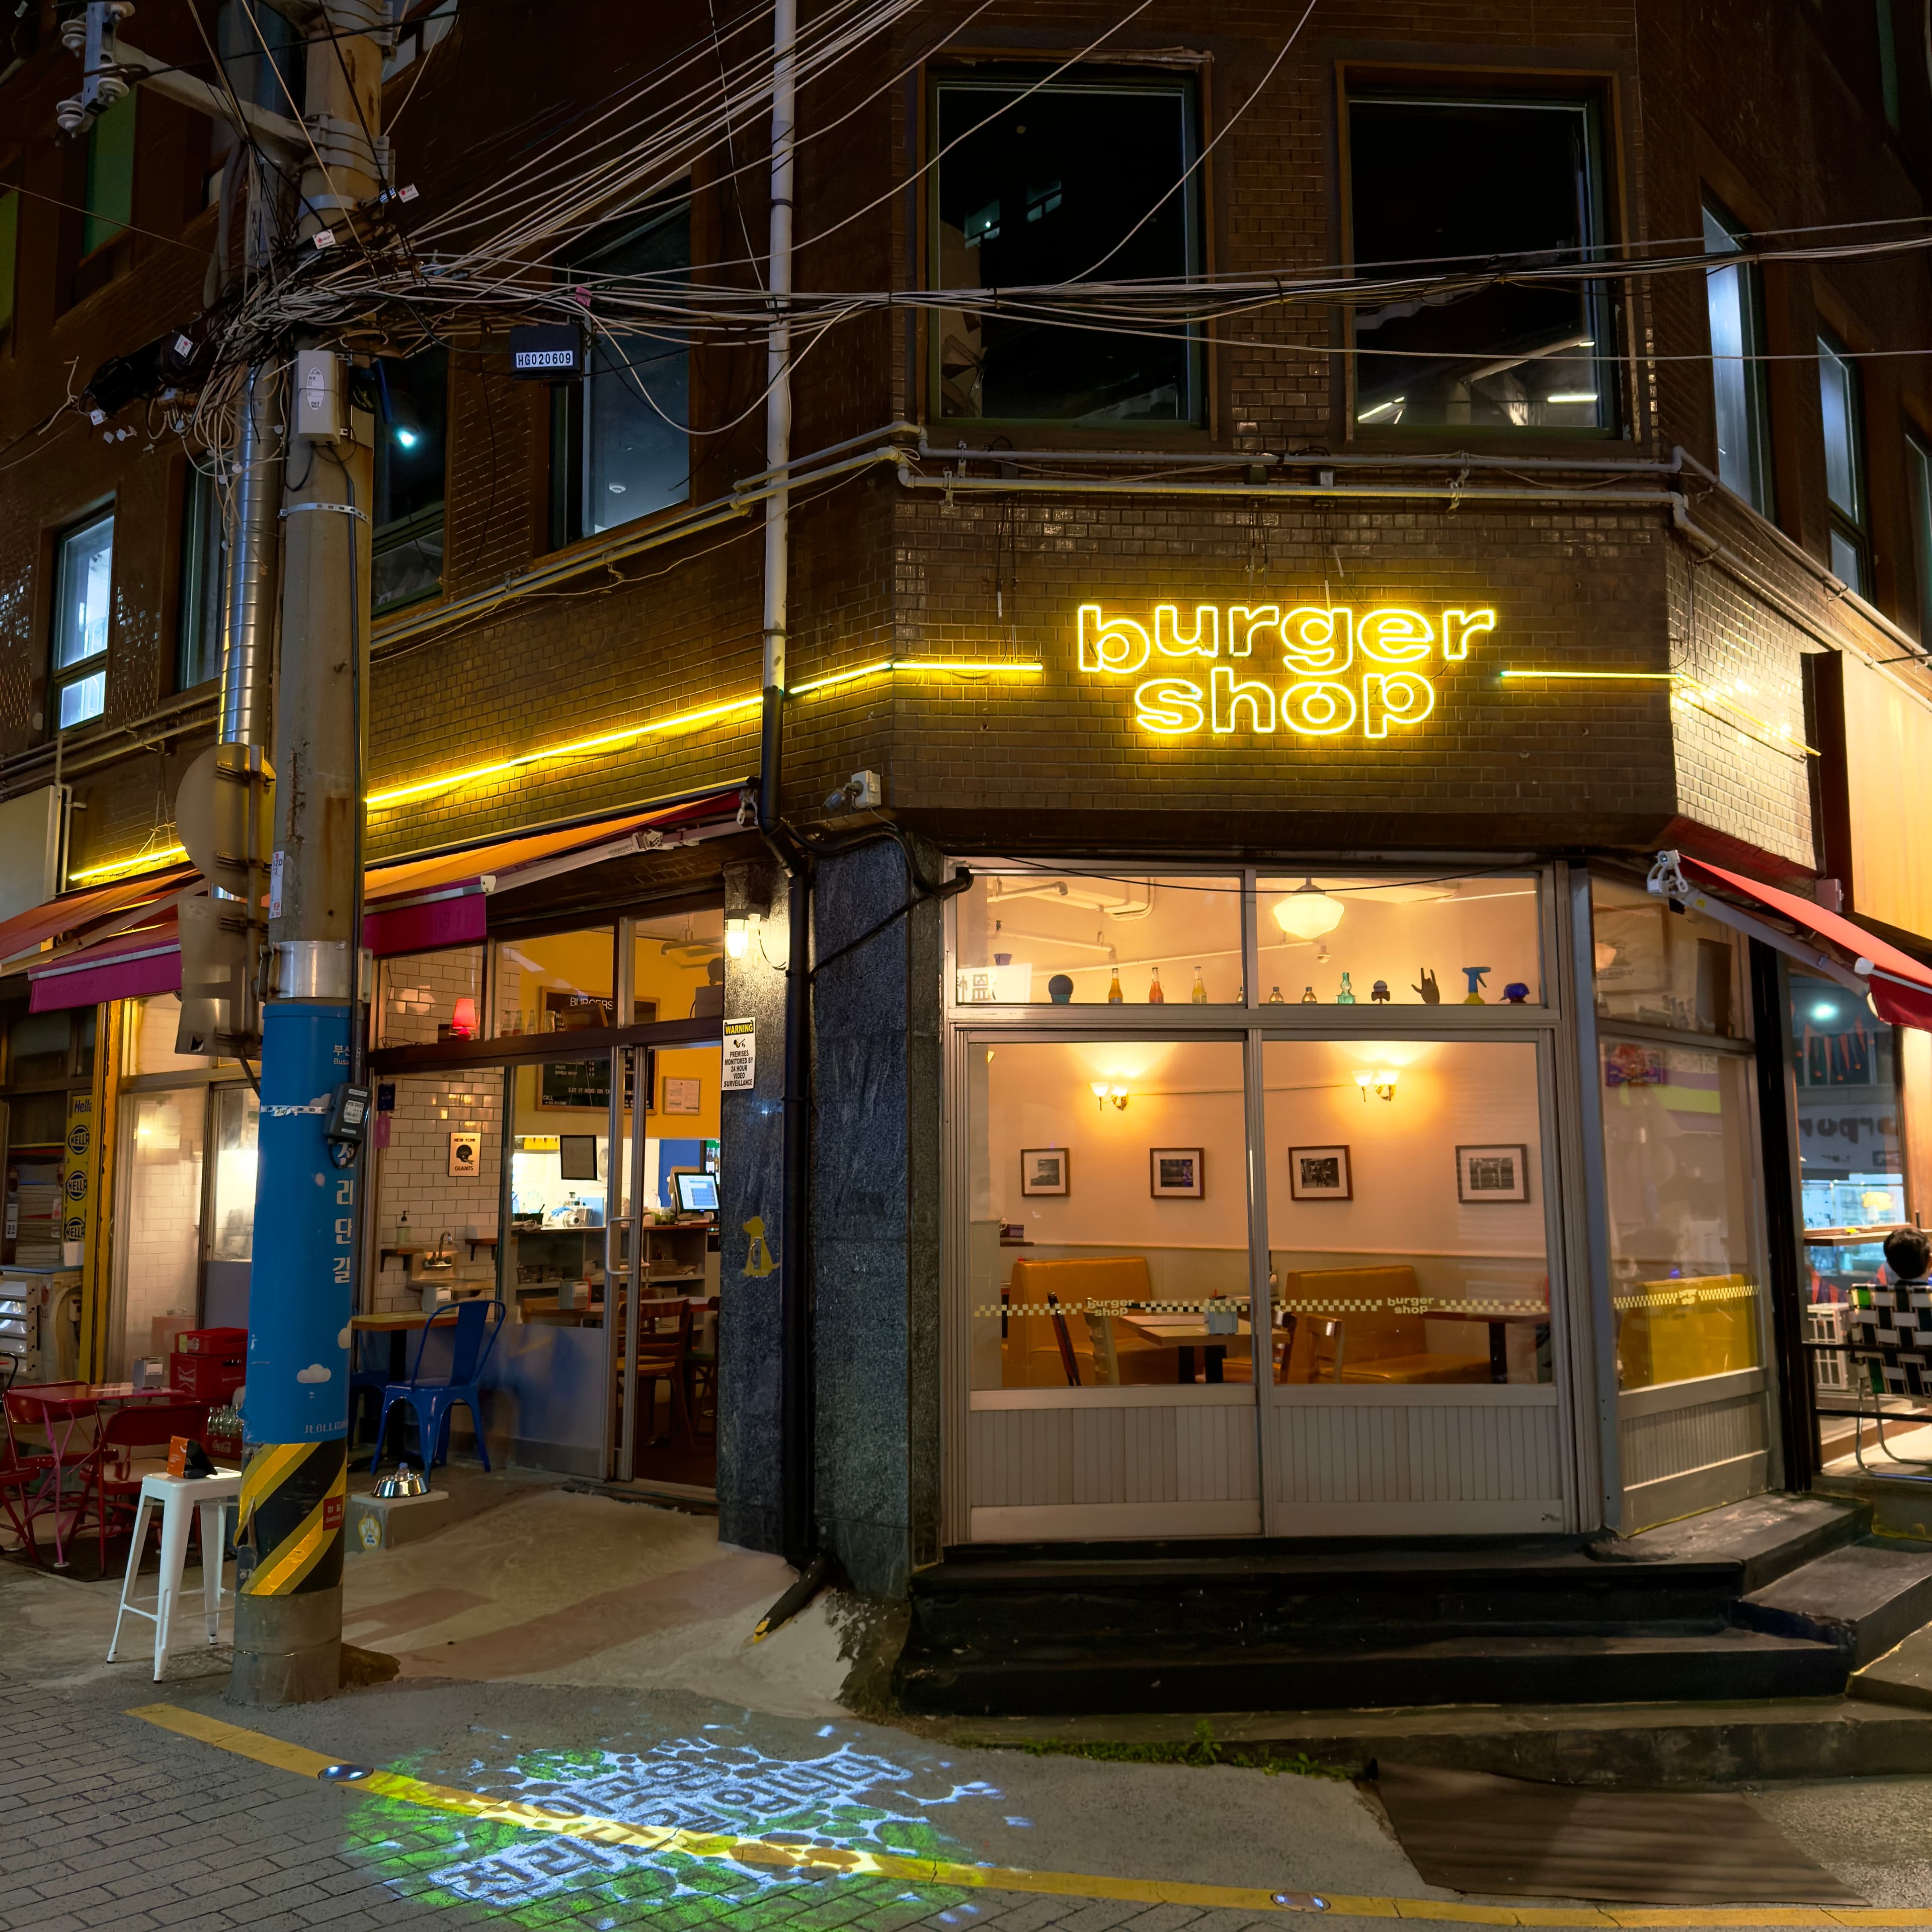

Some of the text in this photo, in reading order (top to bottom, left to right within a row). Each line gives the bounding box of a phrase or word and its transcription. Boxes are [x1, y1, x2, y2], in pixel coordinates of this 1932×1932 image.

[518, 353, 571, 366] HG020609
[1078, 604, 1496, 675] burger
[1135, 667, 1435, 739] shop
[726, 1023, 753, 1034] WARNING
[71, 1133, 89, 1145] HELLA
[68, 1179, 87, 1191] HELLA
[66, 1226, 85, 1238] HELLA
[1087, 1300, 1135, 1309] burger
[1387, 1298, 1434, 1306] burger
[1094, 1308, 1128, 1317] shop
[1394, 1305, 1428, 1314] shop
